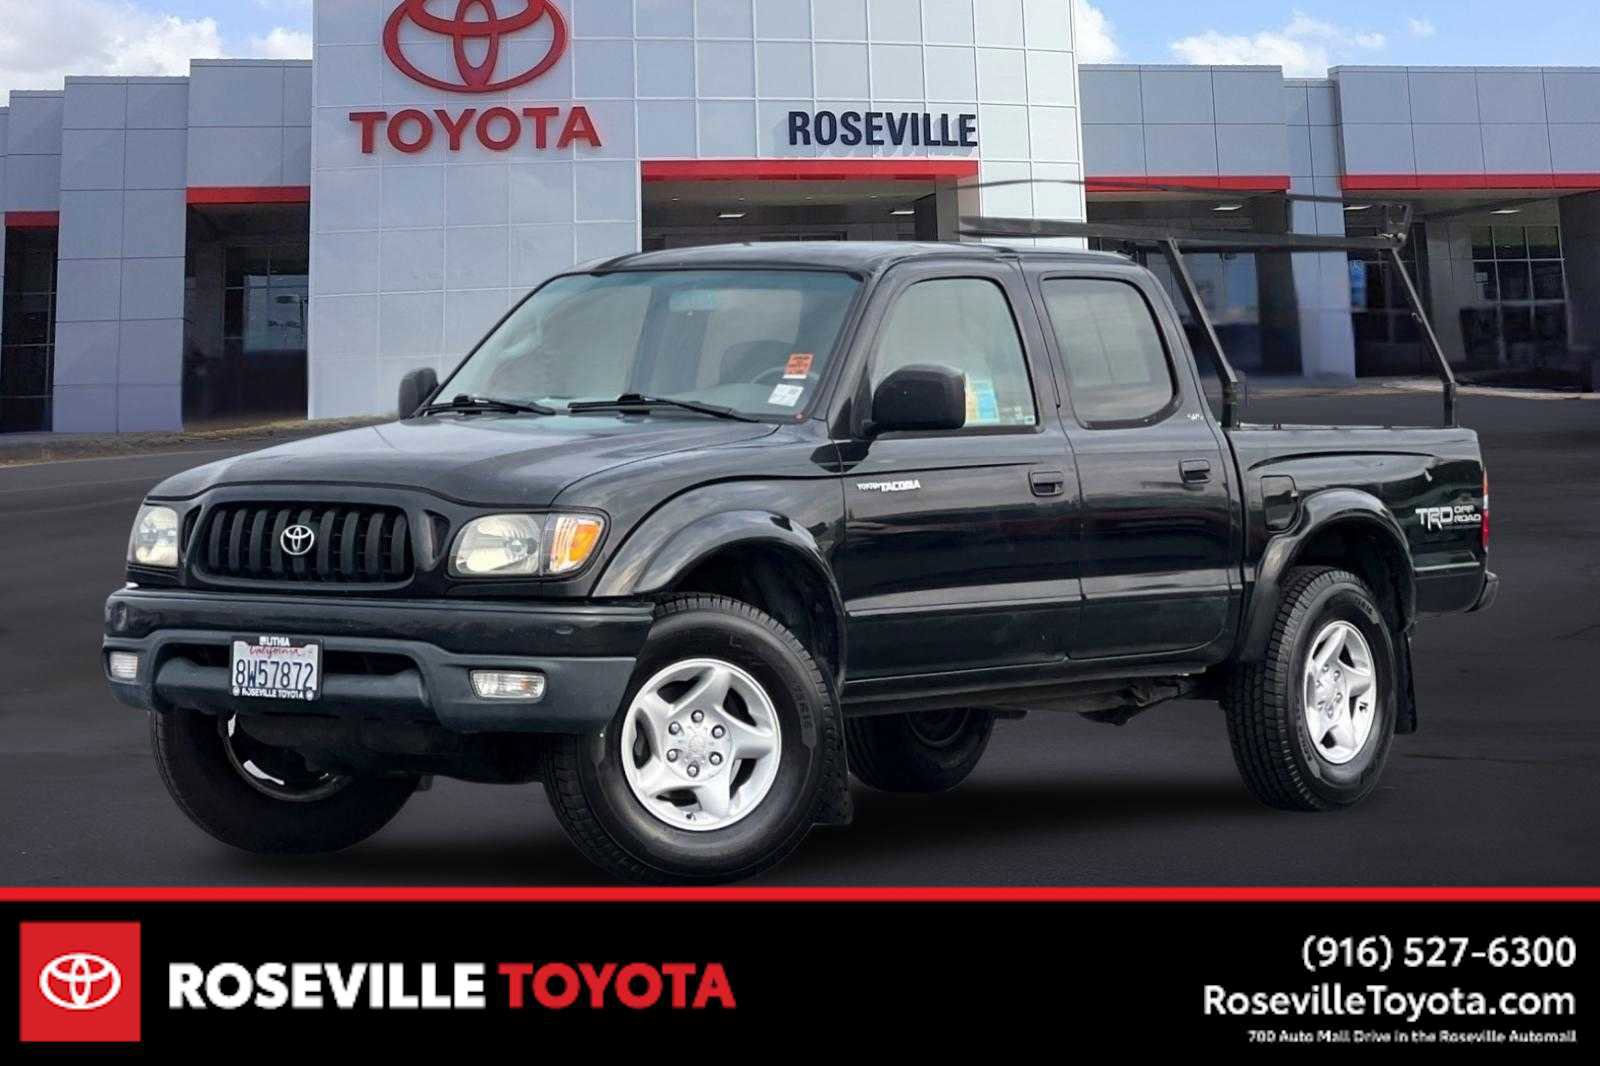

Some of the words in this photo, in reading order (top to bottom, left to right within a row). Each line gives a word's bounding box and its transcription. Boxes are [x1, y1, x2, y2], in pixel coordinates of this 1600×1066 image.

[349, 105, 602, 154] TOYOTA
[788, 110, 978, 147] ROSEVILLE
[1415, 505, 1454, 531] TRD
[1454, 504, 1474, 514] OFF
[1454, 513, 1482, 523] ROAD
[236, 659, 314, 690] 8W57872
[241, 687, 277, 698] ROSEVILLE
[278, 689, 304, 699] TOYOTA
